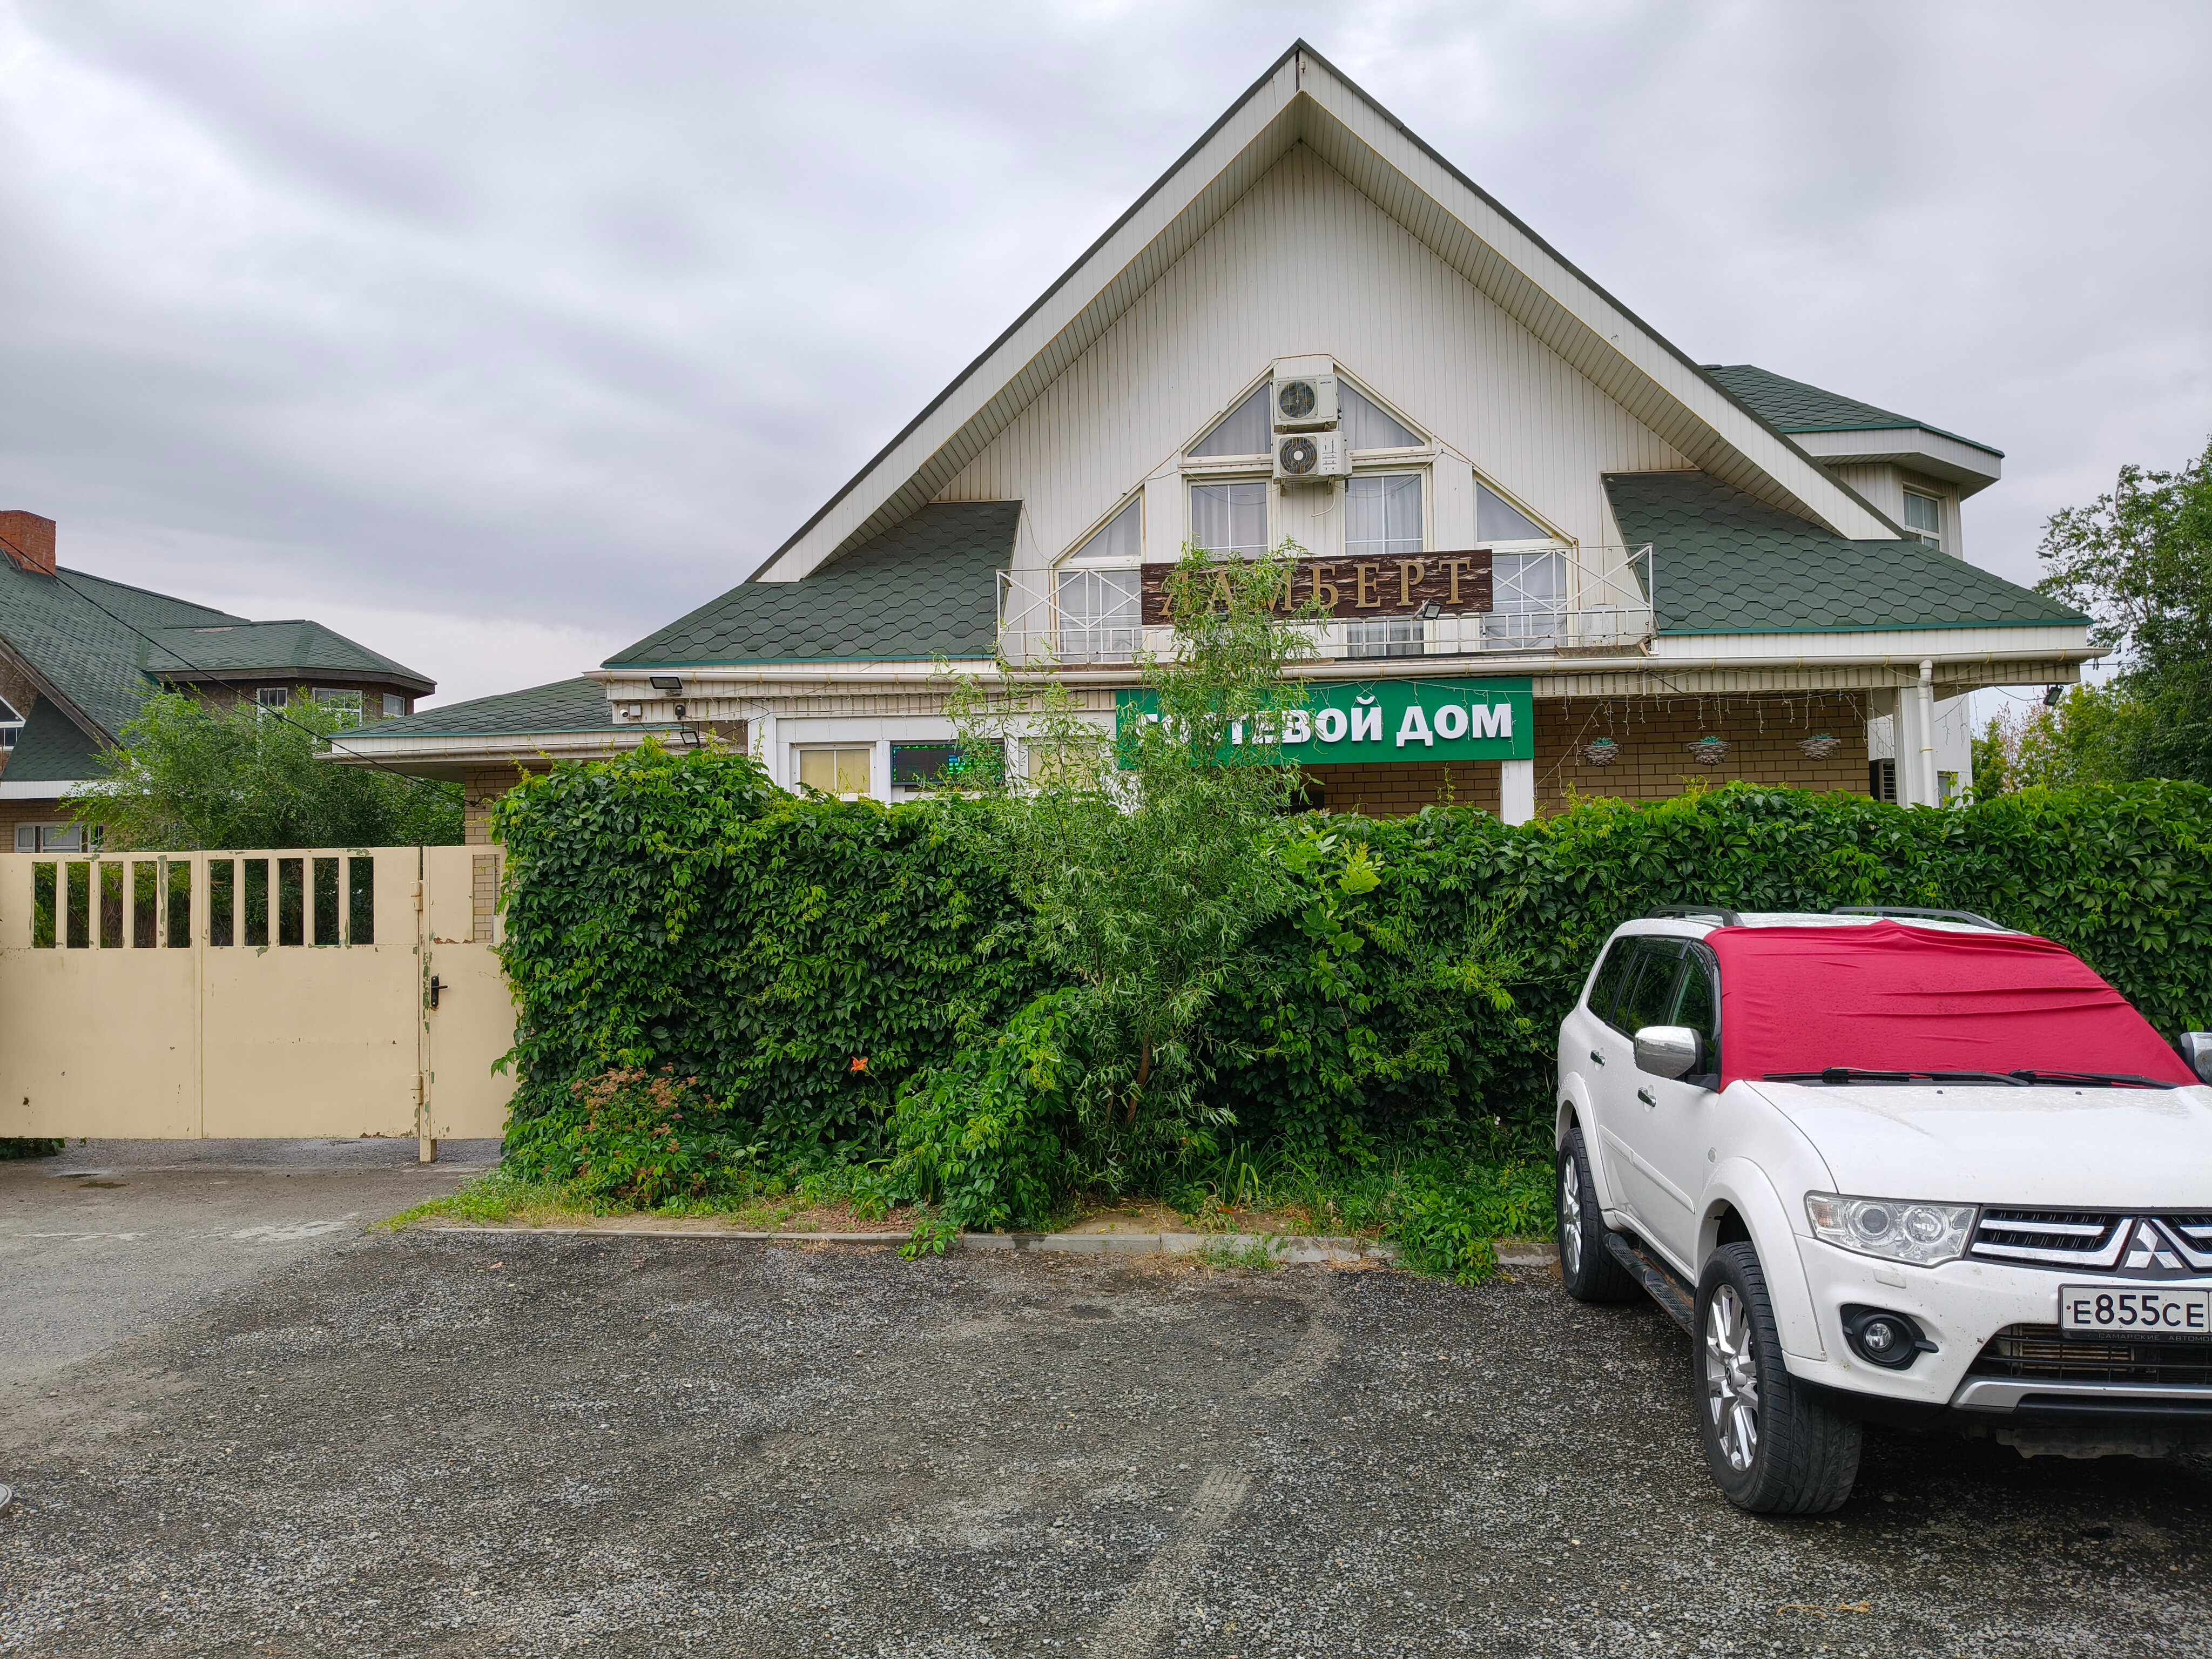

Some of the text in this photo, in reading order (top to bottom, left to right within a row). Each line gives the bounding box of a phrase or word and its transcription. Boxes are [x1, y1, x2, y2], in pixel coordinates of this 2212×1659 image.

[1136, 696, 1513, 747] ГОТЕВОЙ ДОМ
[2073, 1294, 2204, 1327] Е855СЕ
